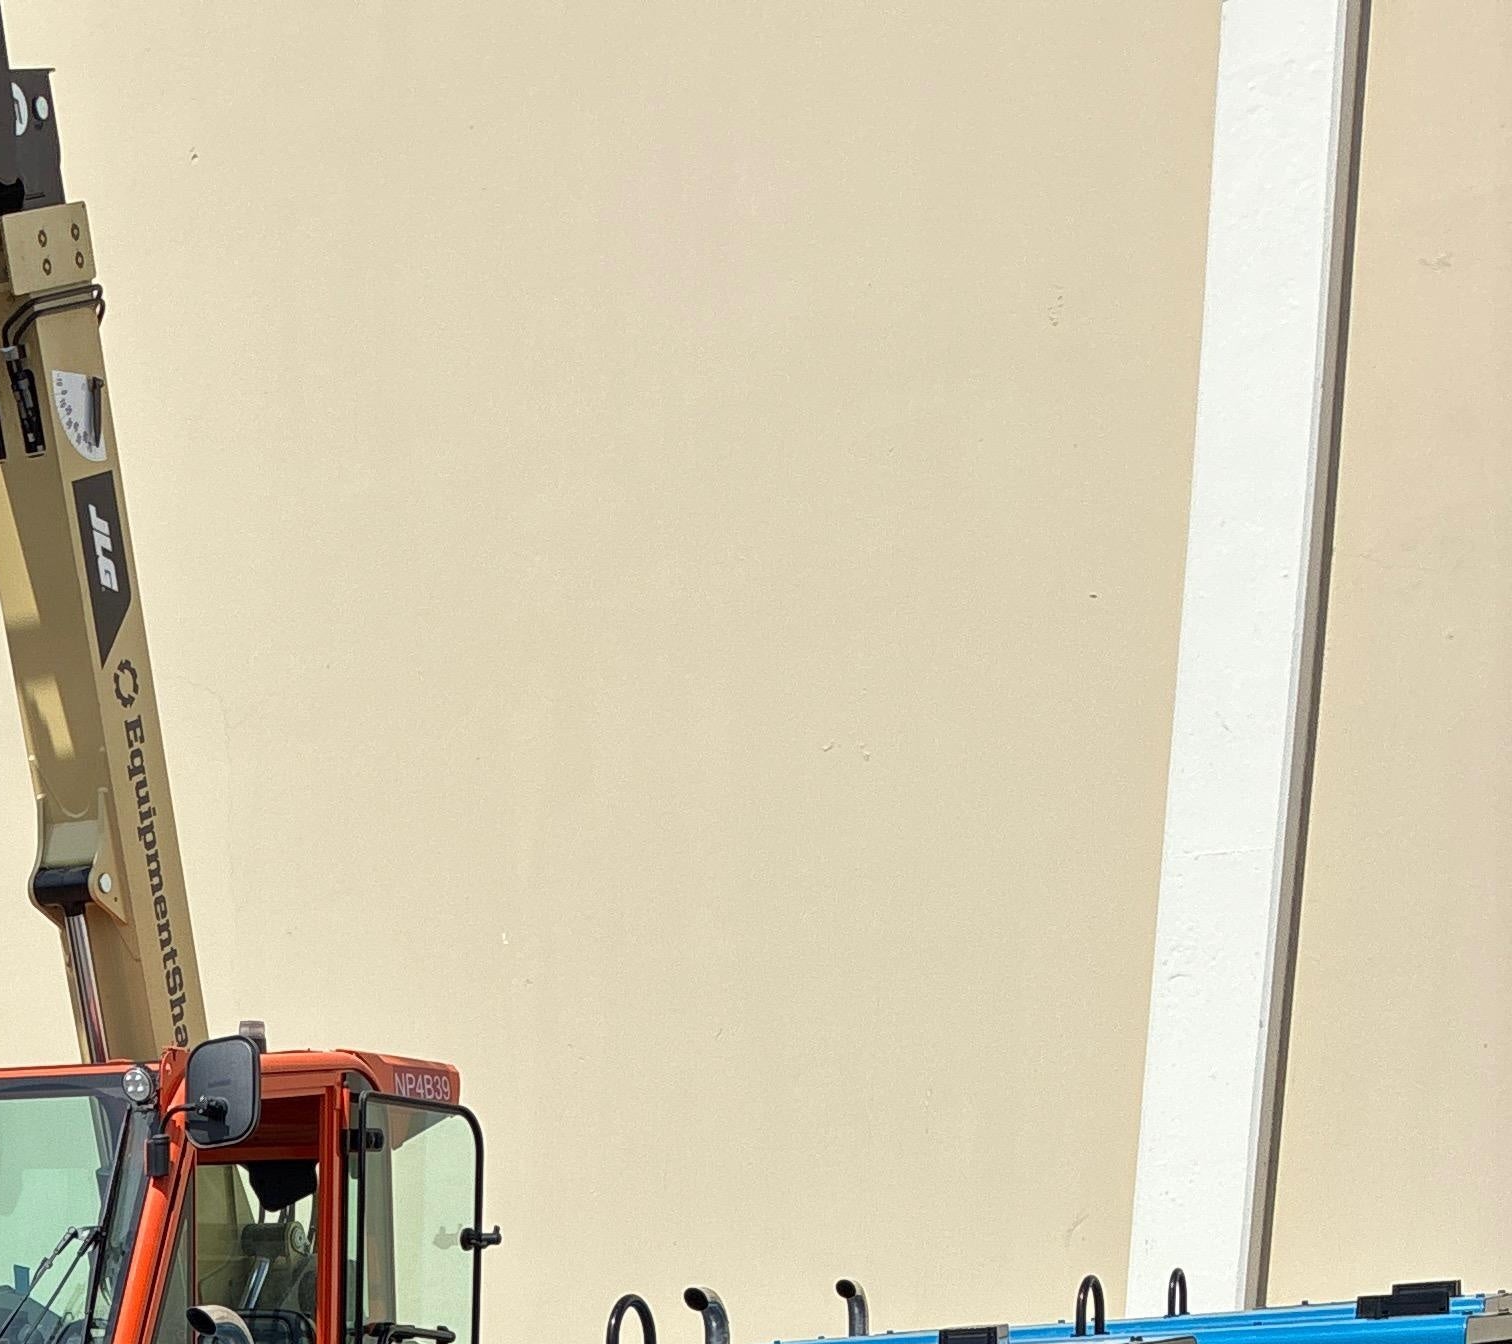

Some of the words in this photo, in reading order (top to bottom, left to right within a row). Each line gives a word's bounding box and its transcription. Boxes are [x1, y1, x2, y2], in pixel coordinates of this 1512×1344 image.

[88, 503, 120, 593] JLG
[123, 714, 192, 1049] EquipmentSha
[394, 1072, 451, 1101] NP4B39
